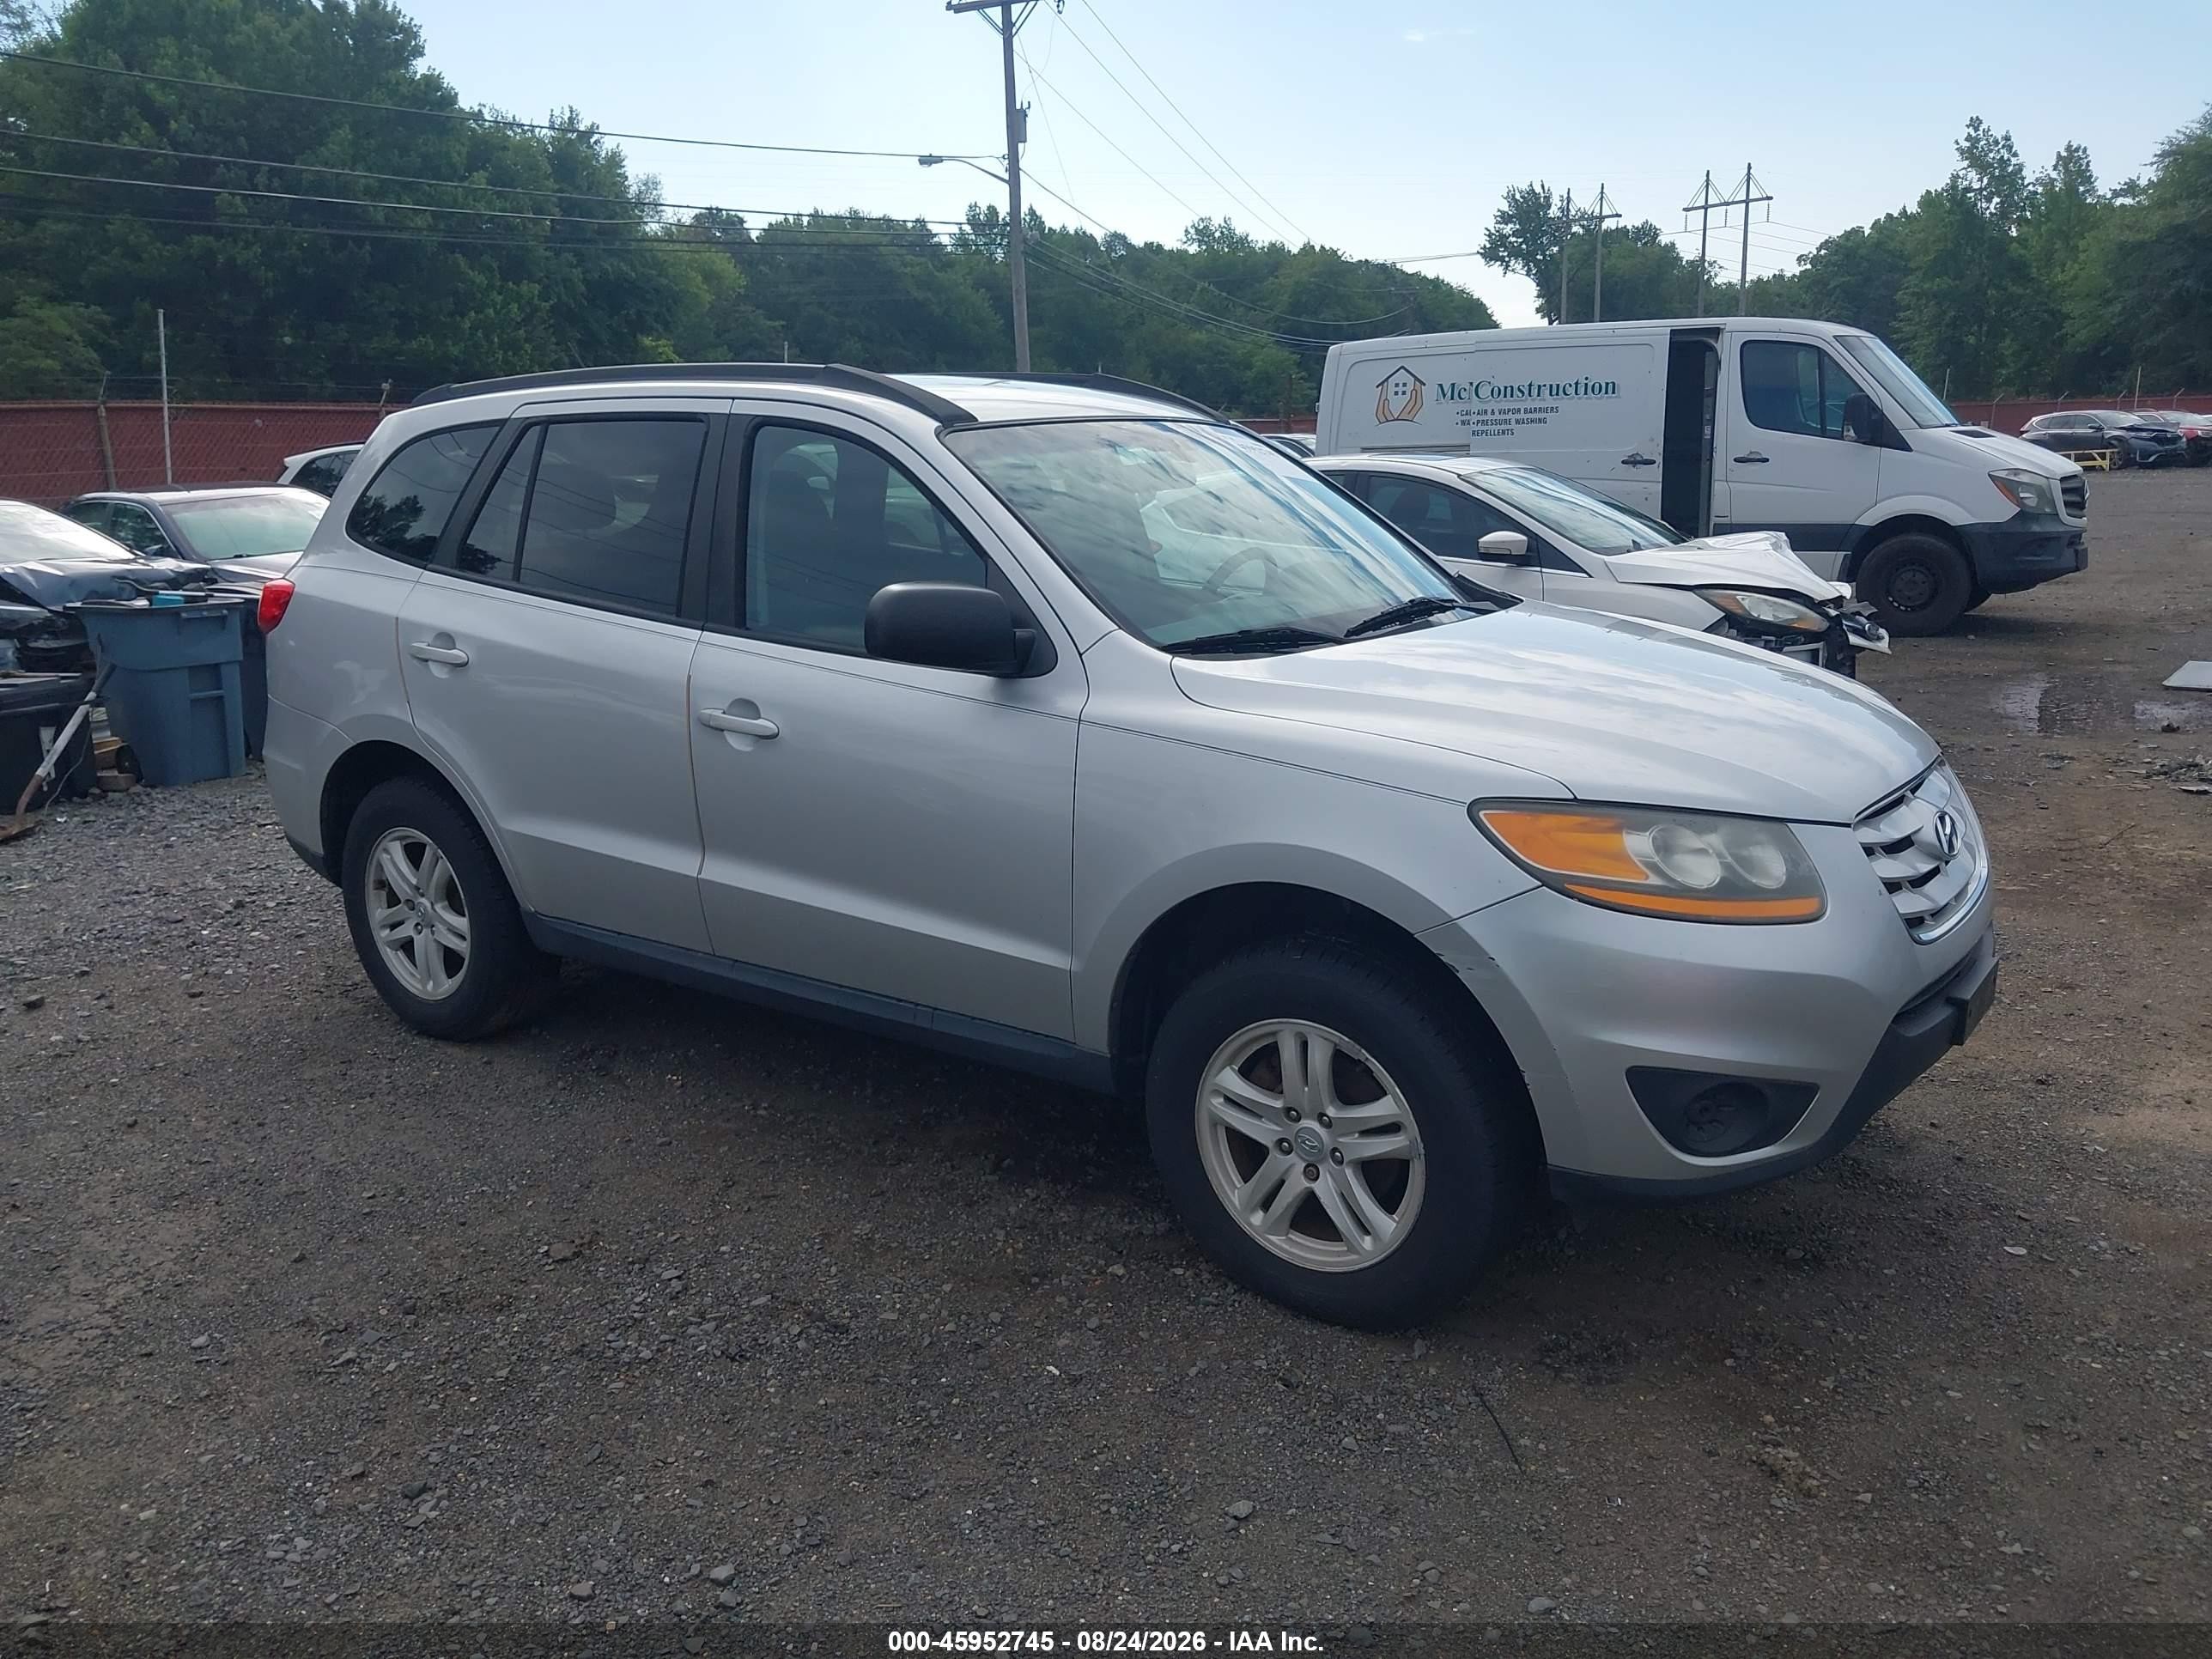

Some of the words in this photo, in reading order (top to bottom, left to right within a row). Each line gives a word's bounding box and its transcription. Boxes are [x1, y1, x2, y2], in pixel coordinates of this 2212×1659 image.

[1498, 407, 1522, 416] VAPOR
[1523, 405, 1559, 415] BARRIERS
[1476, 418, 1512, 427] PRESSURE
[1514, 416, 1547, 426] WASHING
[1471, 428, 1515, 437] REPELLENTS
